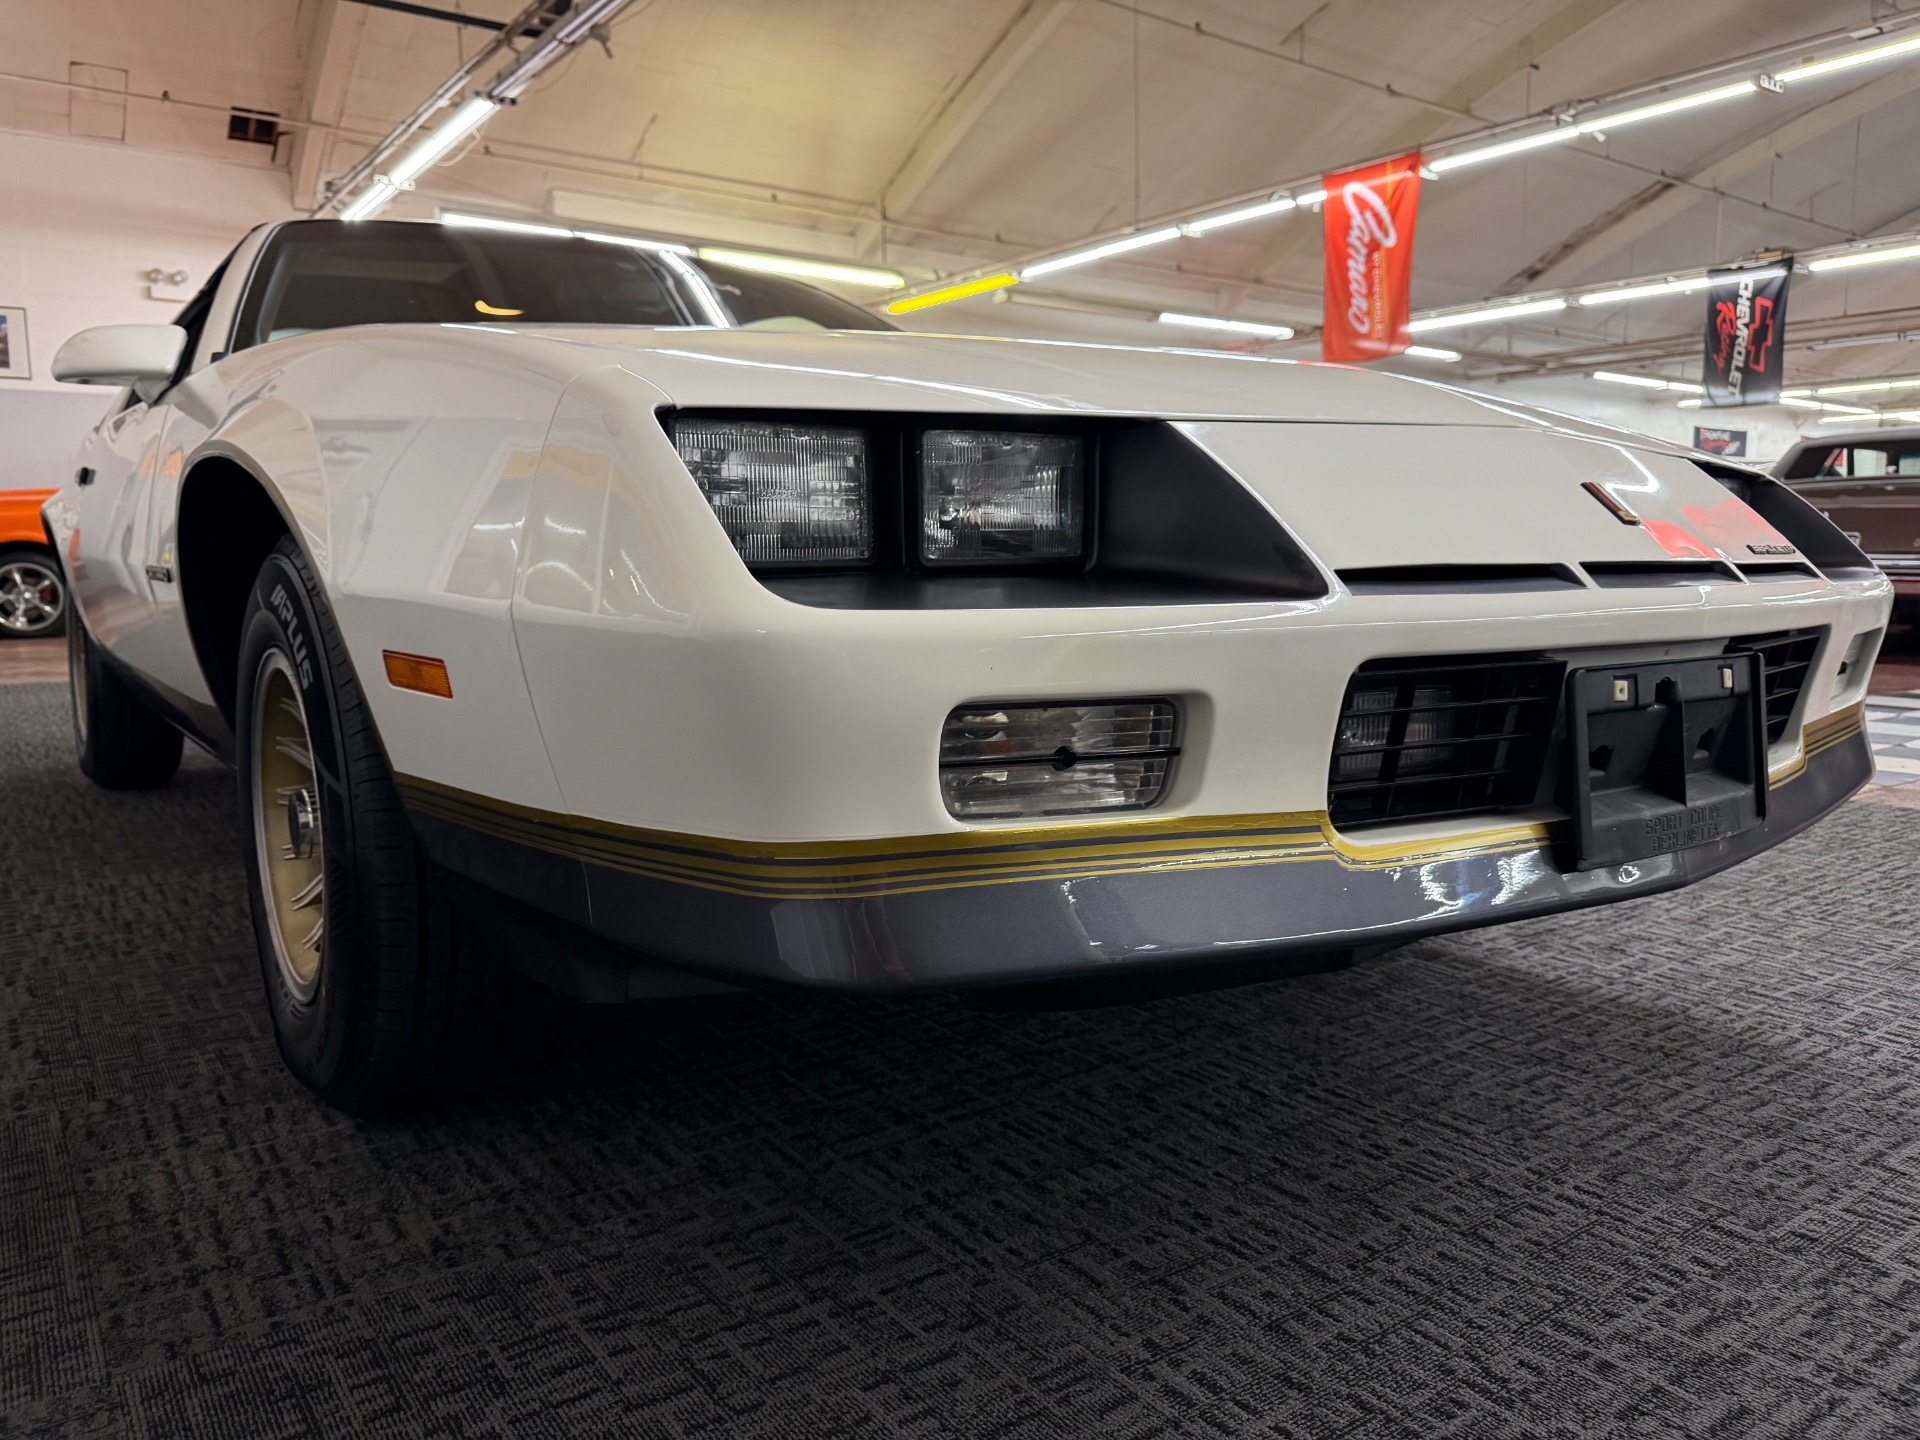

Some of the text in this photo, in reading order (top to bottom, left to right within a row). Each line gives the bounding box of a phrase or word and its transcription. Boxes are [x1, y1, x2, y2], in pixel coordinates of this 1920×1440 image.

[1342, 181, 1397, 334] Camaro
[1713, 301, 1737, 375] Racing
[1728, 276, 1754, 398] CHEVROLET
[1645, 803, 1723, 836] SPORT COUPE
[1652, 822, 1719, 852] BERLINETTA
